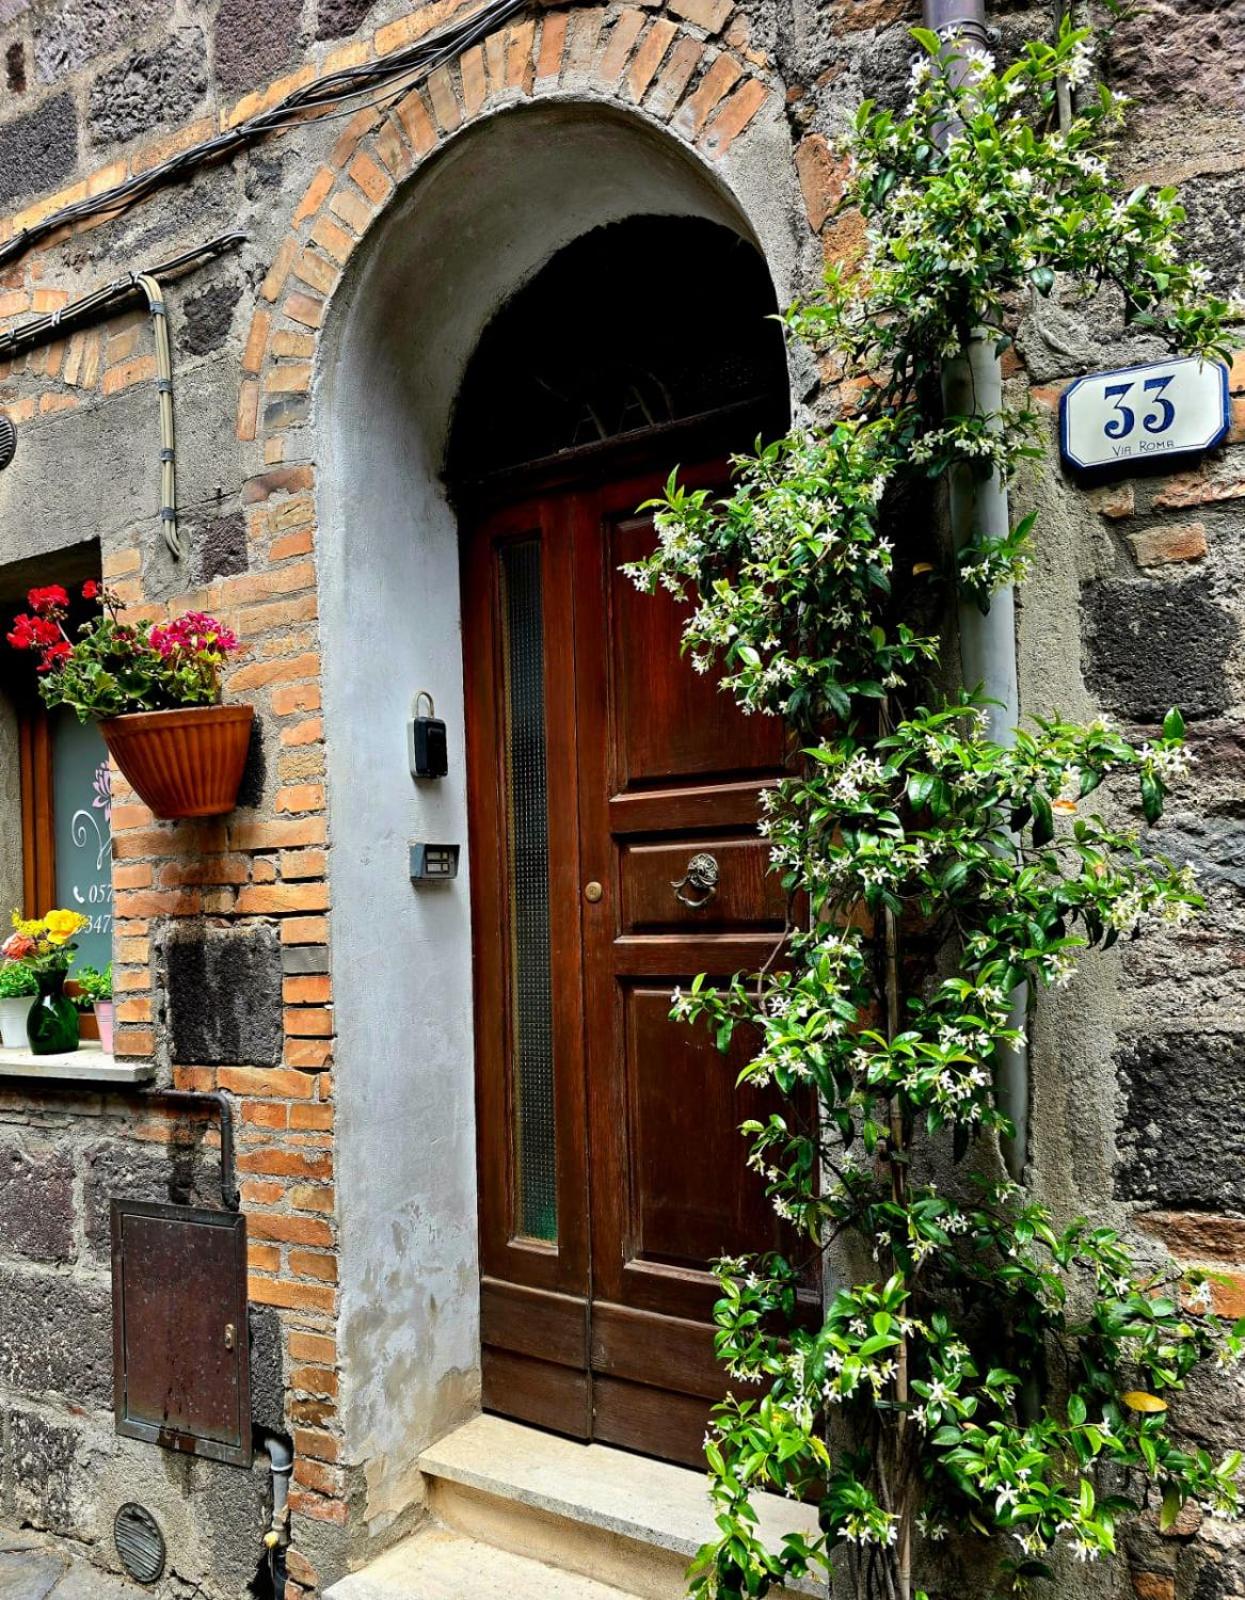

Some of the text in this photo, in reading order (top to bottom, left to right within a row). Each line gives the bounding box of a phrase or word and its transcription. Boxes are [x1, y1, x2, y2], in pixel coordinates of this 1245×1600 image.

[1103, 374, 1176, 440] 33
[1139, 439, 1175, 453] ROMA
[84, 914, 113, 934] 347
